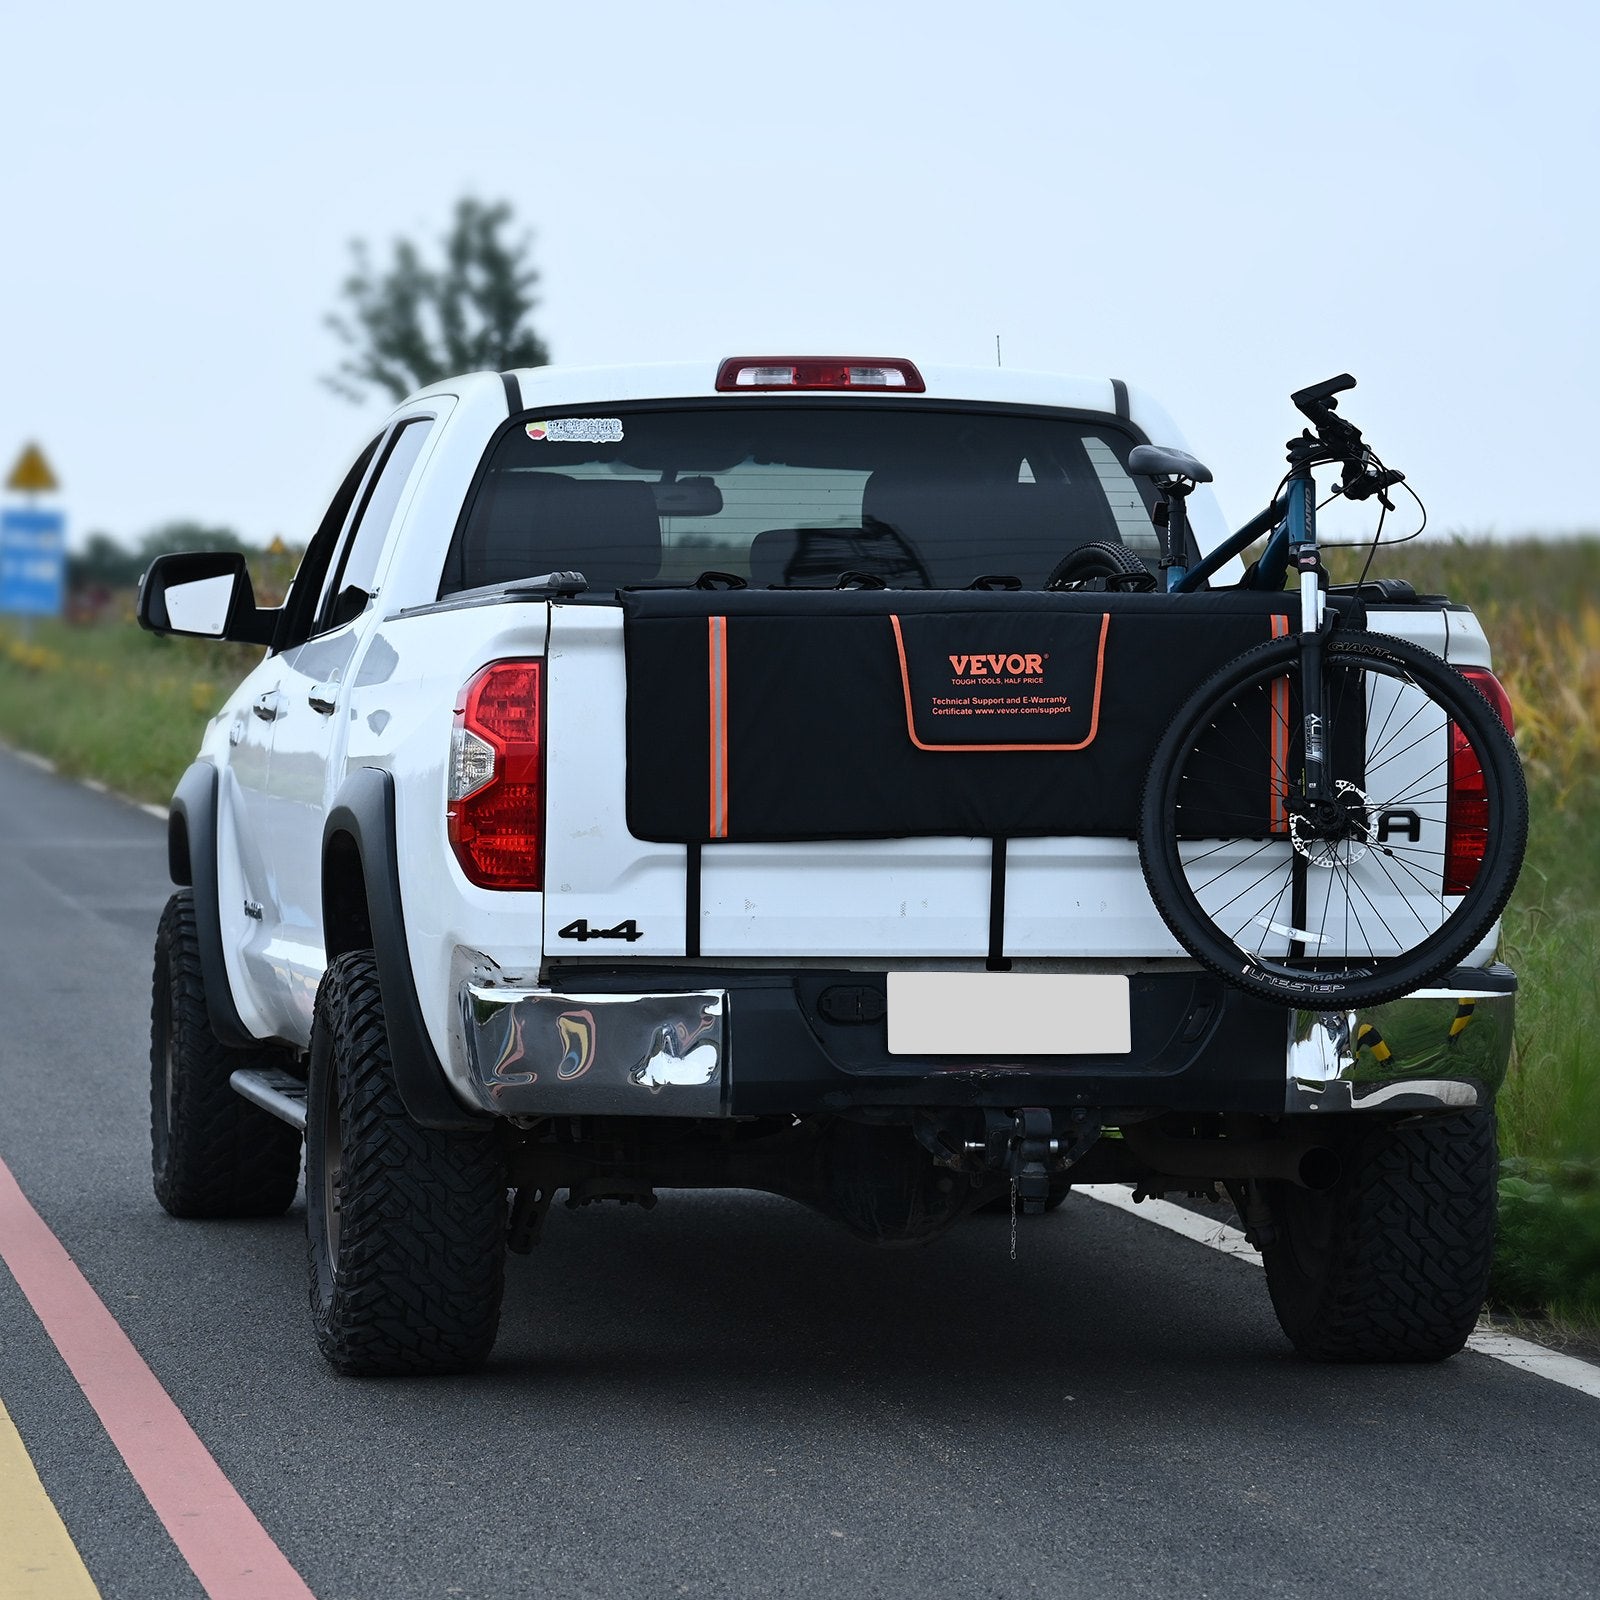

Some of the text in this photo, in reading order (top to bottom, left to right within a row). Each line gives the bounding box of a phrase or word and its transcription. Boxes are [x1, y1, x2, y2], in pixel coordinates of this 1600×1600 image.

[1327, 642, 1391, 657] GIANT
[949, 653, 1043, 675] VEVOR
[932, 696, 1067, 706] Technical Support and E-Warranty
[932, 706, 1071, 715] Certificate www.vevor.com/support
[558, 919, 644, 942] 4x4
